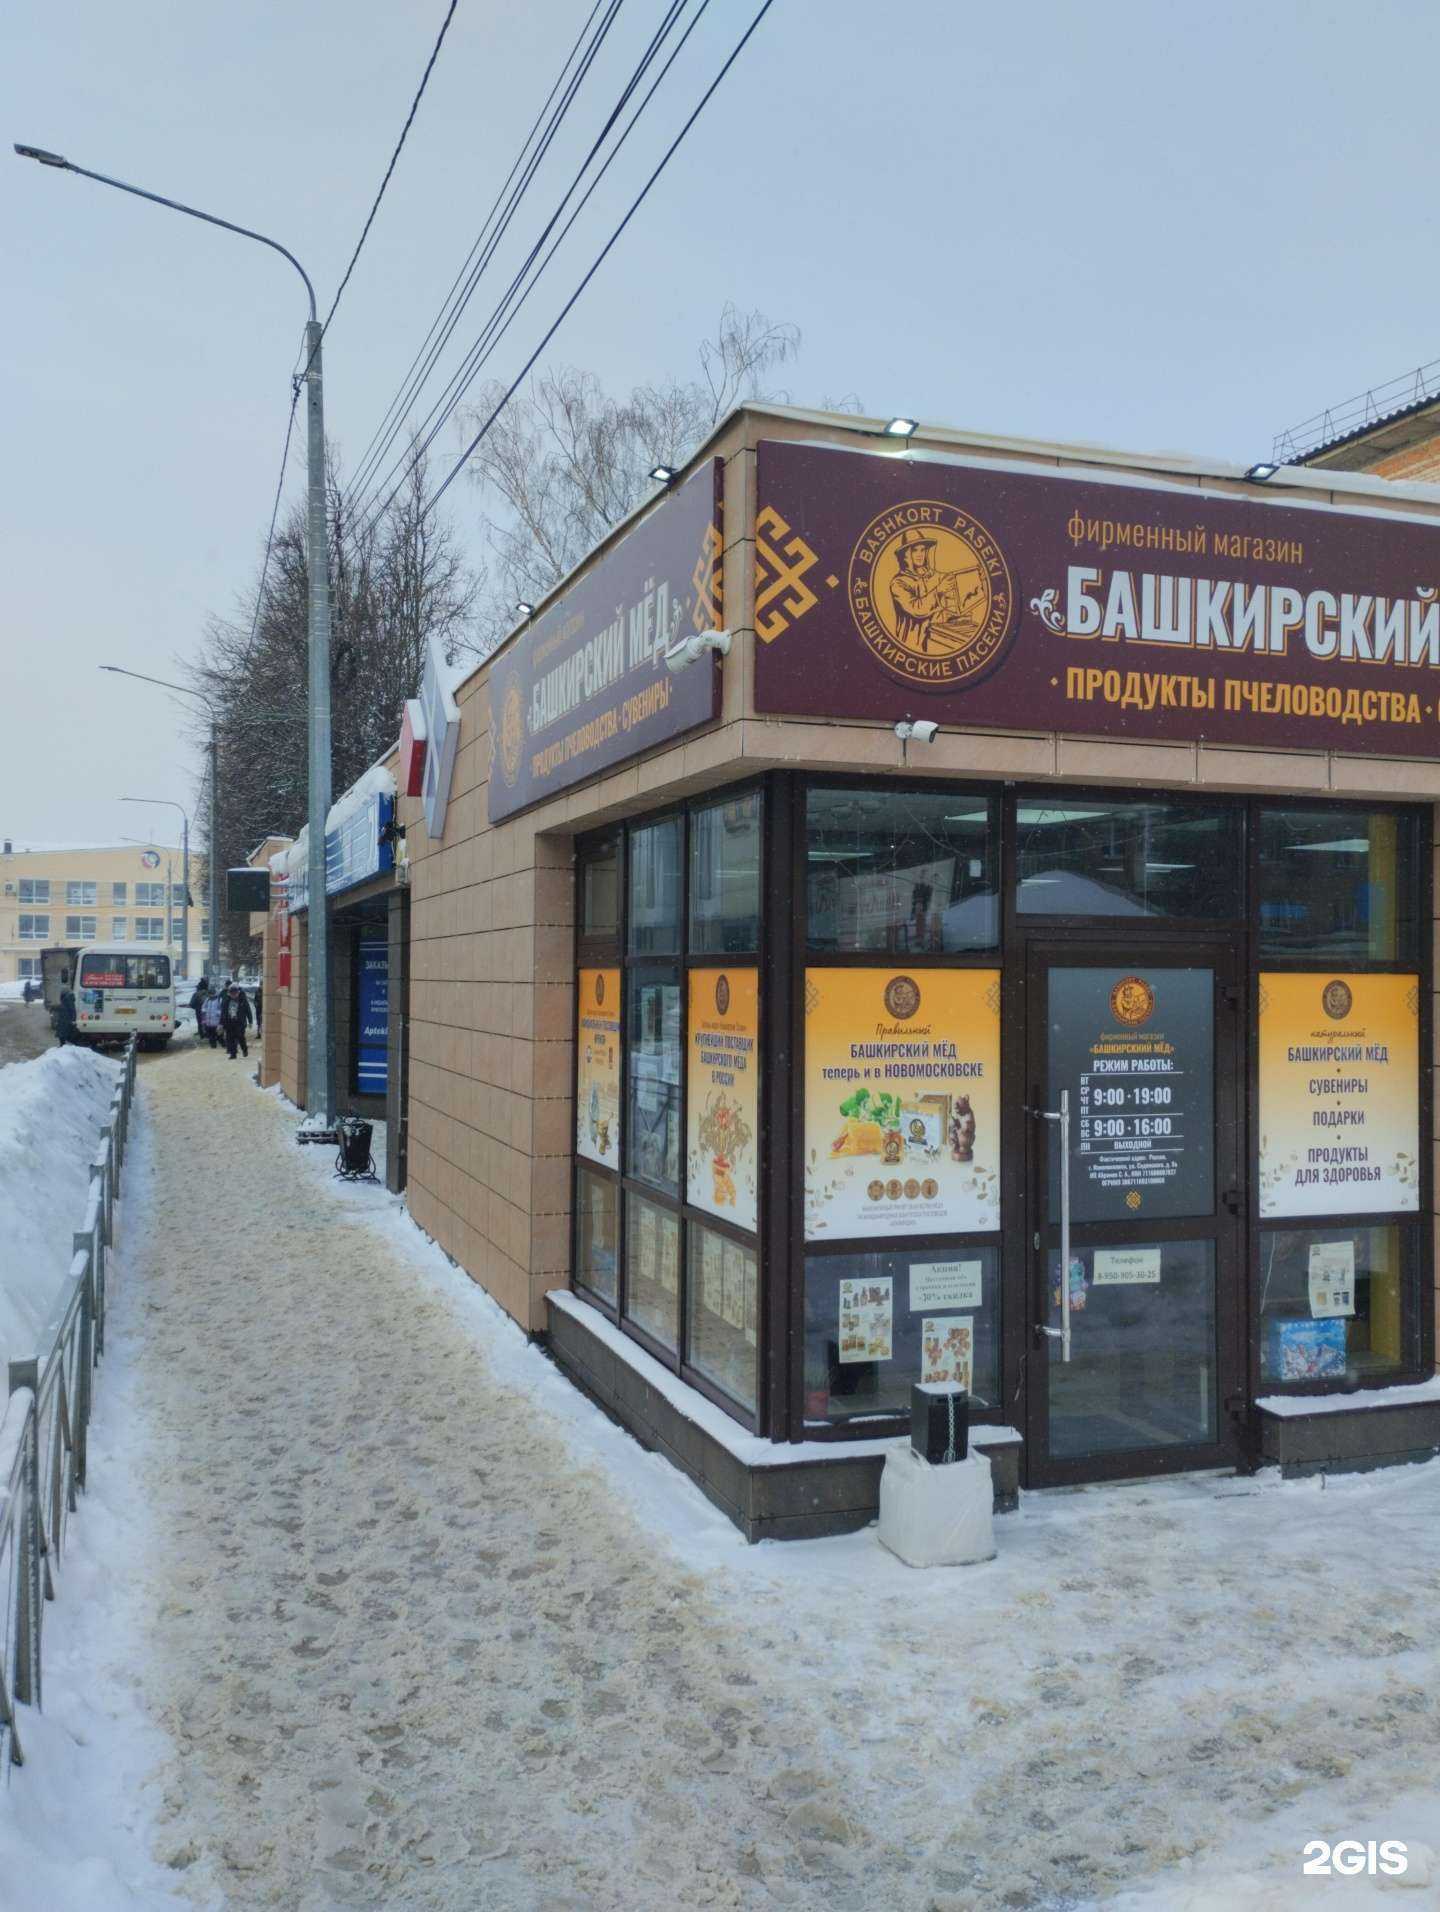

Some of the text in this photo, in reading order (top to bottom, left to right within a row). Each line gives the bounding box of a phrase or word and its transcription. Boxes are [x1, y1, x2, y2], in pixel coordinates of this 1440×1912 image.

[859, 507, 1002, 577] BASHKORT PASEKI
[1067, 509, 1303, 564] фирменный магазин
[1067, 565, 1440, 668] БАШКИРСКИЙ
[855, 597, 1006, 676] БАШКИРСКИЕ ПАСЕКИ
[533, 603, 624, 735] БАШКИРСКИЙ
[628, 576, 670, 671] МЁД
[622, 676, 669, 732] СУВЕНИРЫ
[1066, 667, 1216, 710] ПРОДУКТЫ
[1224, 679, 1424, 727] ПЧЕЛОВОДСТВА
[850, 1040, 957, 1059] БАШКИРСКИЙ МЁД
[1288, 1043, 1388, 1064] БАШКИРСКИЙ МЁД
[822, 1062, 984, 1081] теперь и в НОВОМОСКОВСКЕ
[1093, 1058, 1174, 1072] РЕЖИМ РАБОТЫ:
[1093, 1087, 1171, 1106] 9:00 19:00
[1309, 1078, 1368, 1095] СУВЕНИРЫ
[1094, 1117, 1171, 1137] 9:00 16:00
[1312, 1110, 1365, 1128] ПОДАРКИ
[1308, 1146, 1368, 1165] ПРОДУКТЫ
[1294, 1166, 1382, 1187] ДЛЯ ЗДОРОВЬЯ
